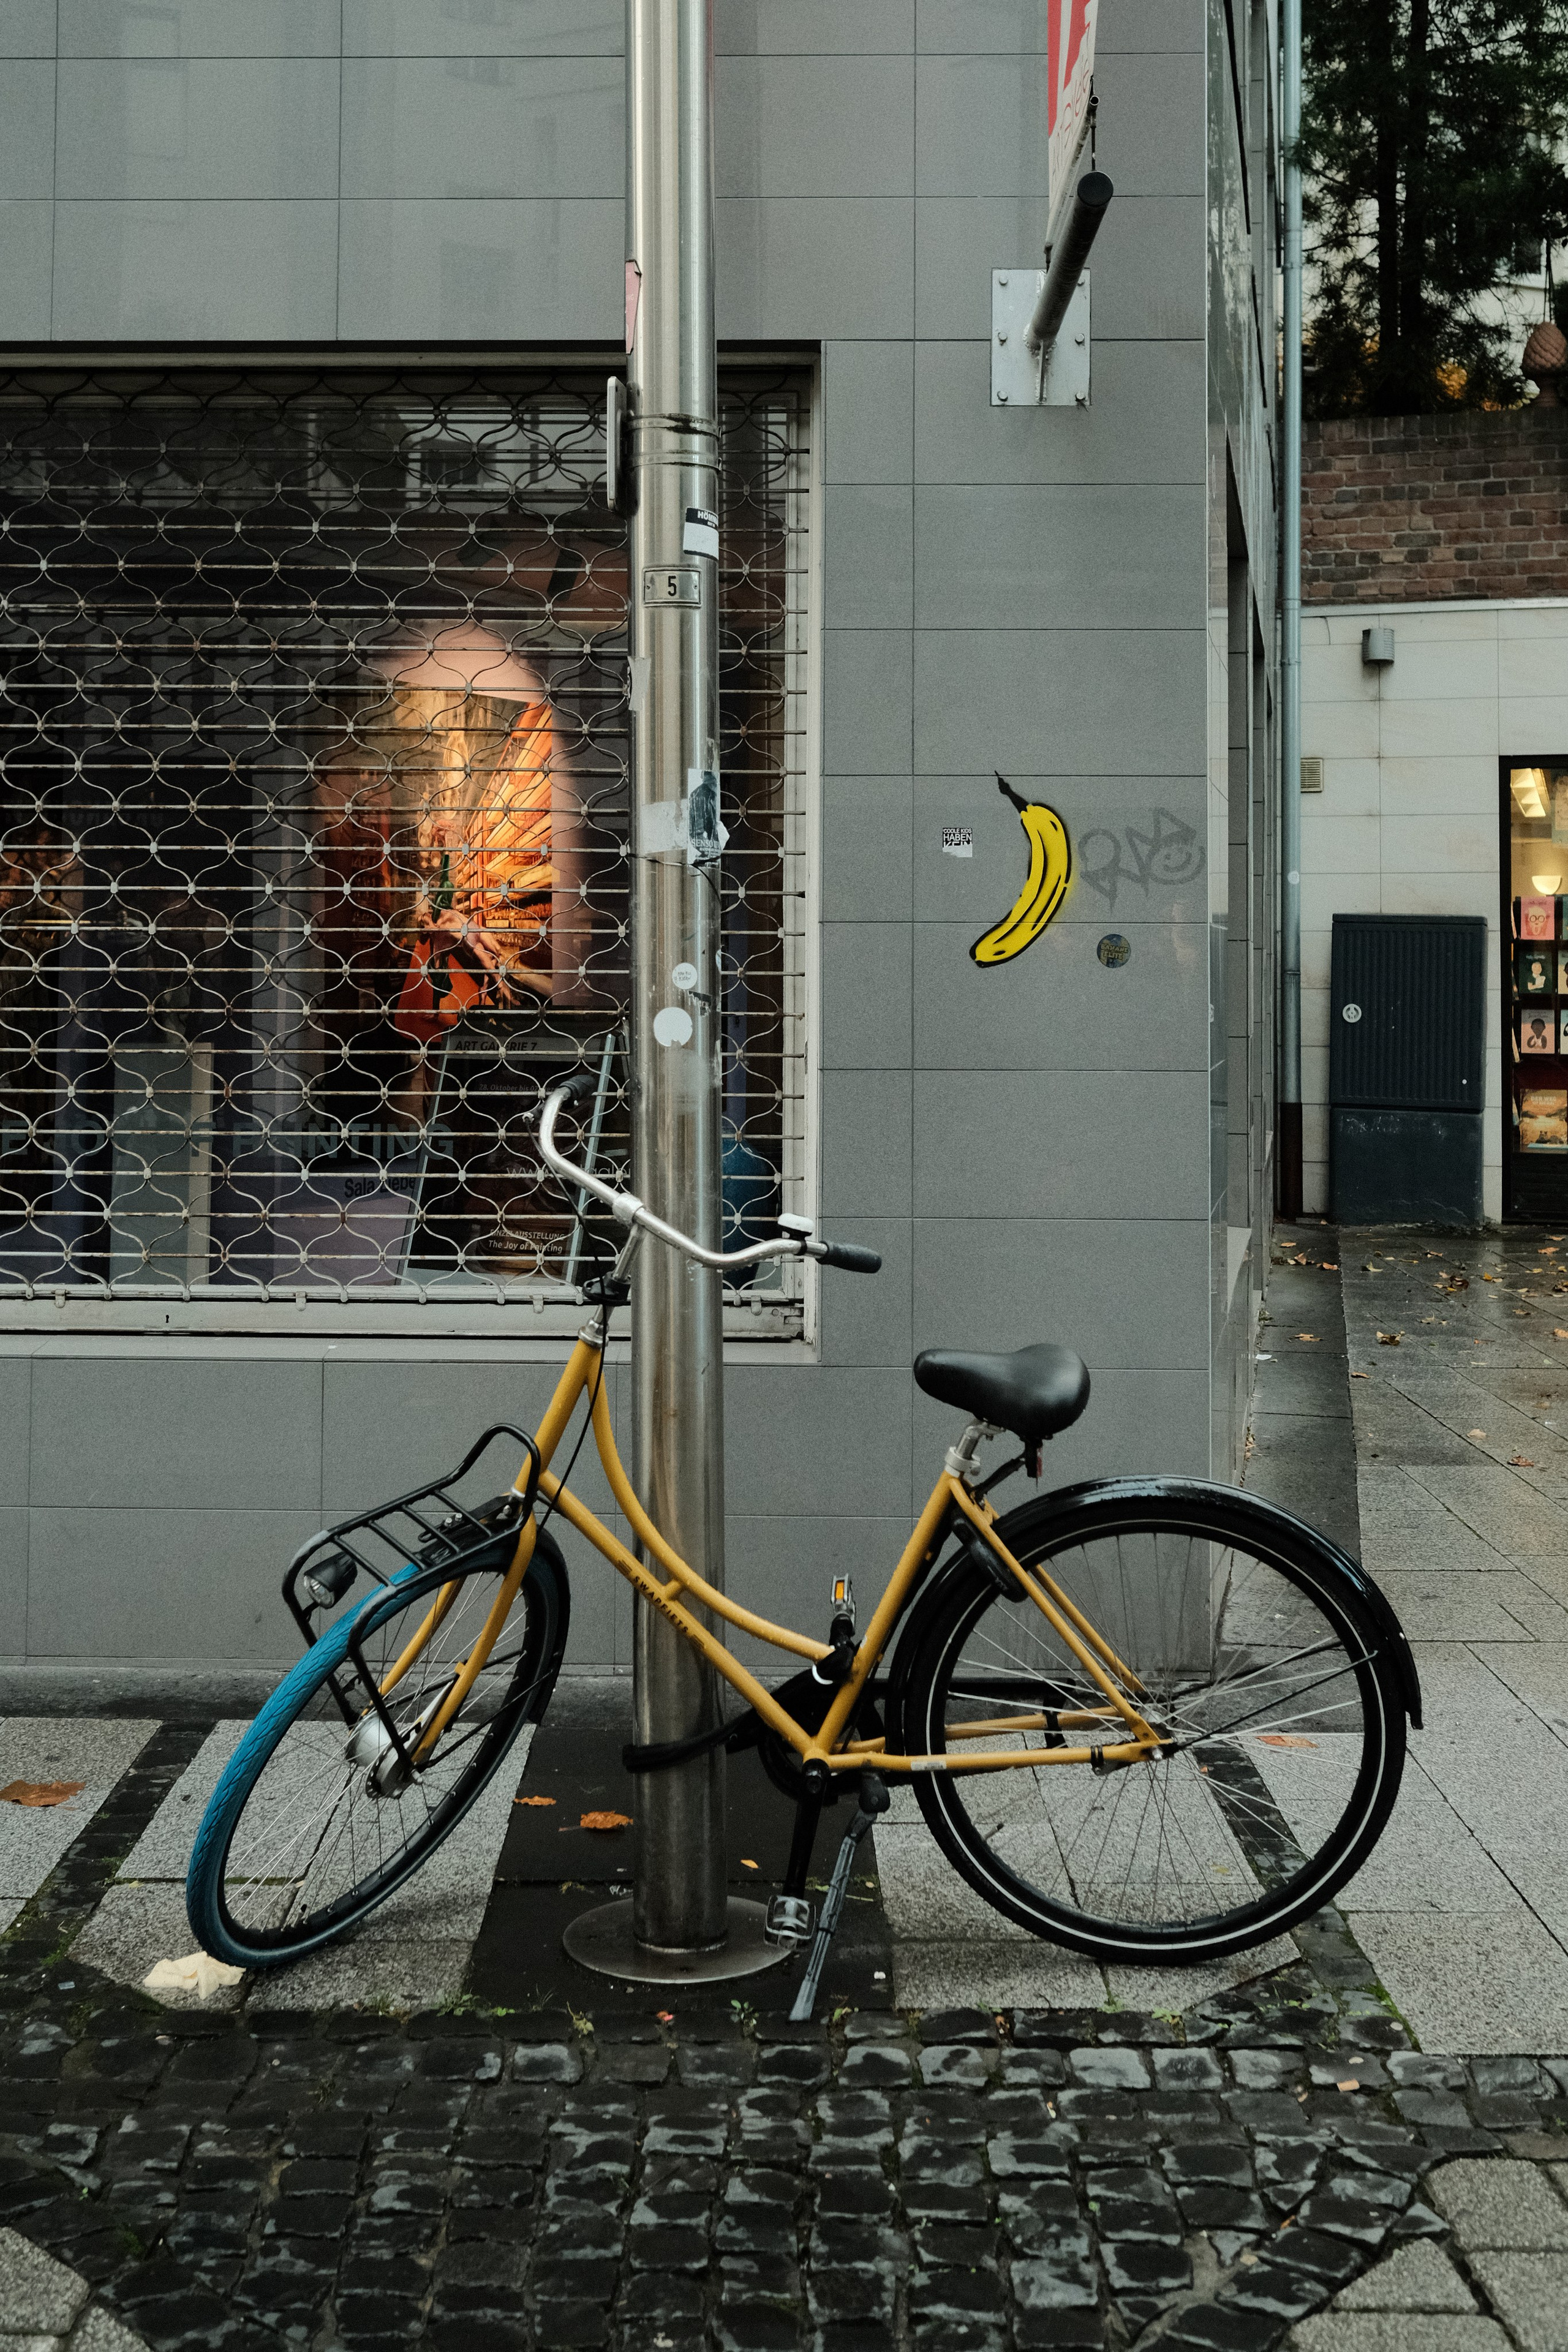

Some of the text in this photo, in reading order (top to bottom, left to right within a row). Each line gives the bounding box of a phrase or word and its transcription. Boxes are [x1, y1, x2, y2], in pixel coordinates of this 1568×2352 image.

[668, 575, 677, 597] 5
[1103, 951, 1123, 960] ELITE
[455, 1041, 478, 1051] ART
[531, 1042, 537, 1051] 7
[344, 1177, 375, 1198] Sala
[489, 1240, 502, 1249] The
[504, 1241, 518, 1251] Joy
[519, 1242, 530, 1250] of
[633, 1575, 688, 1633] SWAPFIETS
